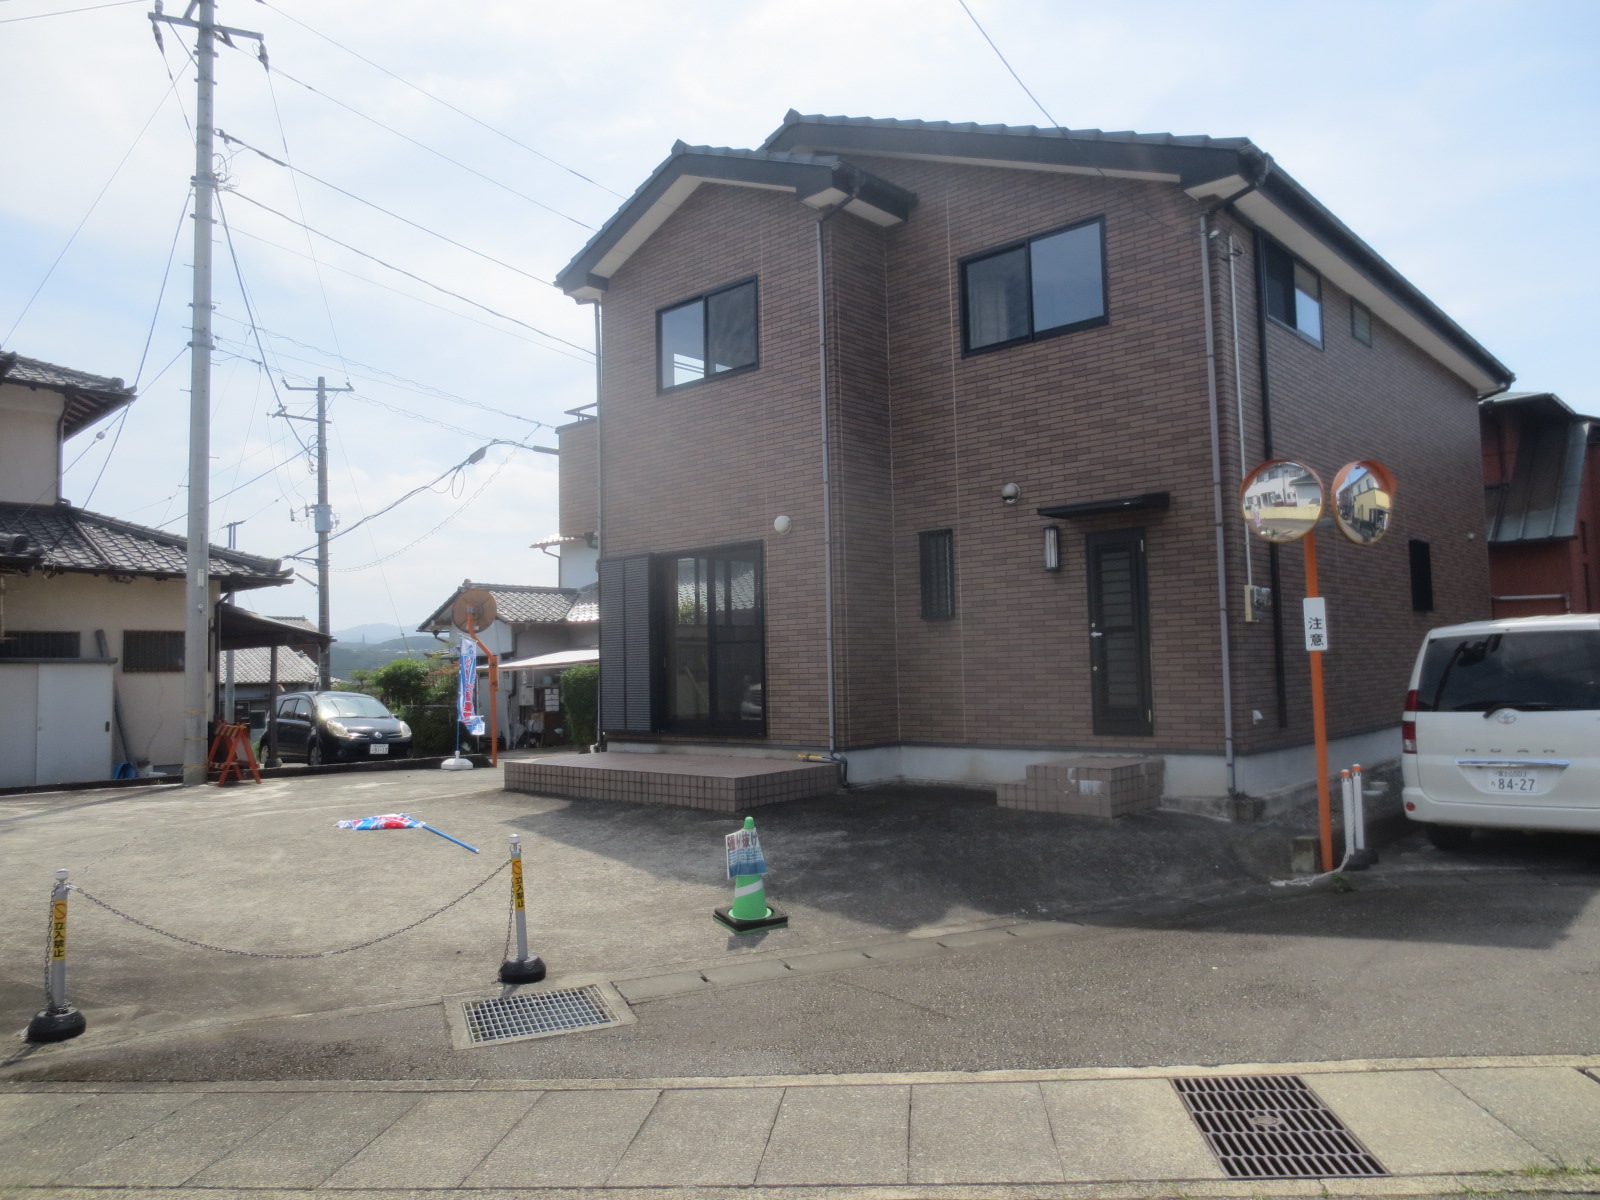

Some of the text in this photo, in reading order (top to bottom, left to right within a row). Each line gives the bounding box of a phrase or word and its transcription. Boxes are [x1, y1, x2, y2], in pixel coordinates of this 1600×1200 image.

[1308, 616, 1324, 647] 注意
[1498, 778, 1535, 791] 84-27
[515, 876, 525, 908] 立入禁止
[53, 922, 65, 958] 立入禁止
